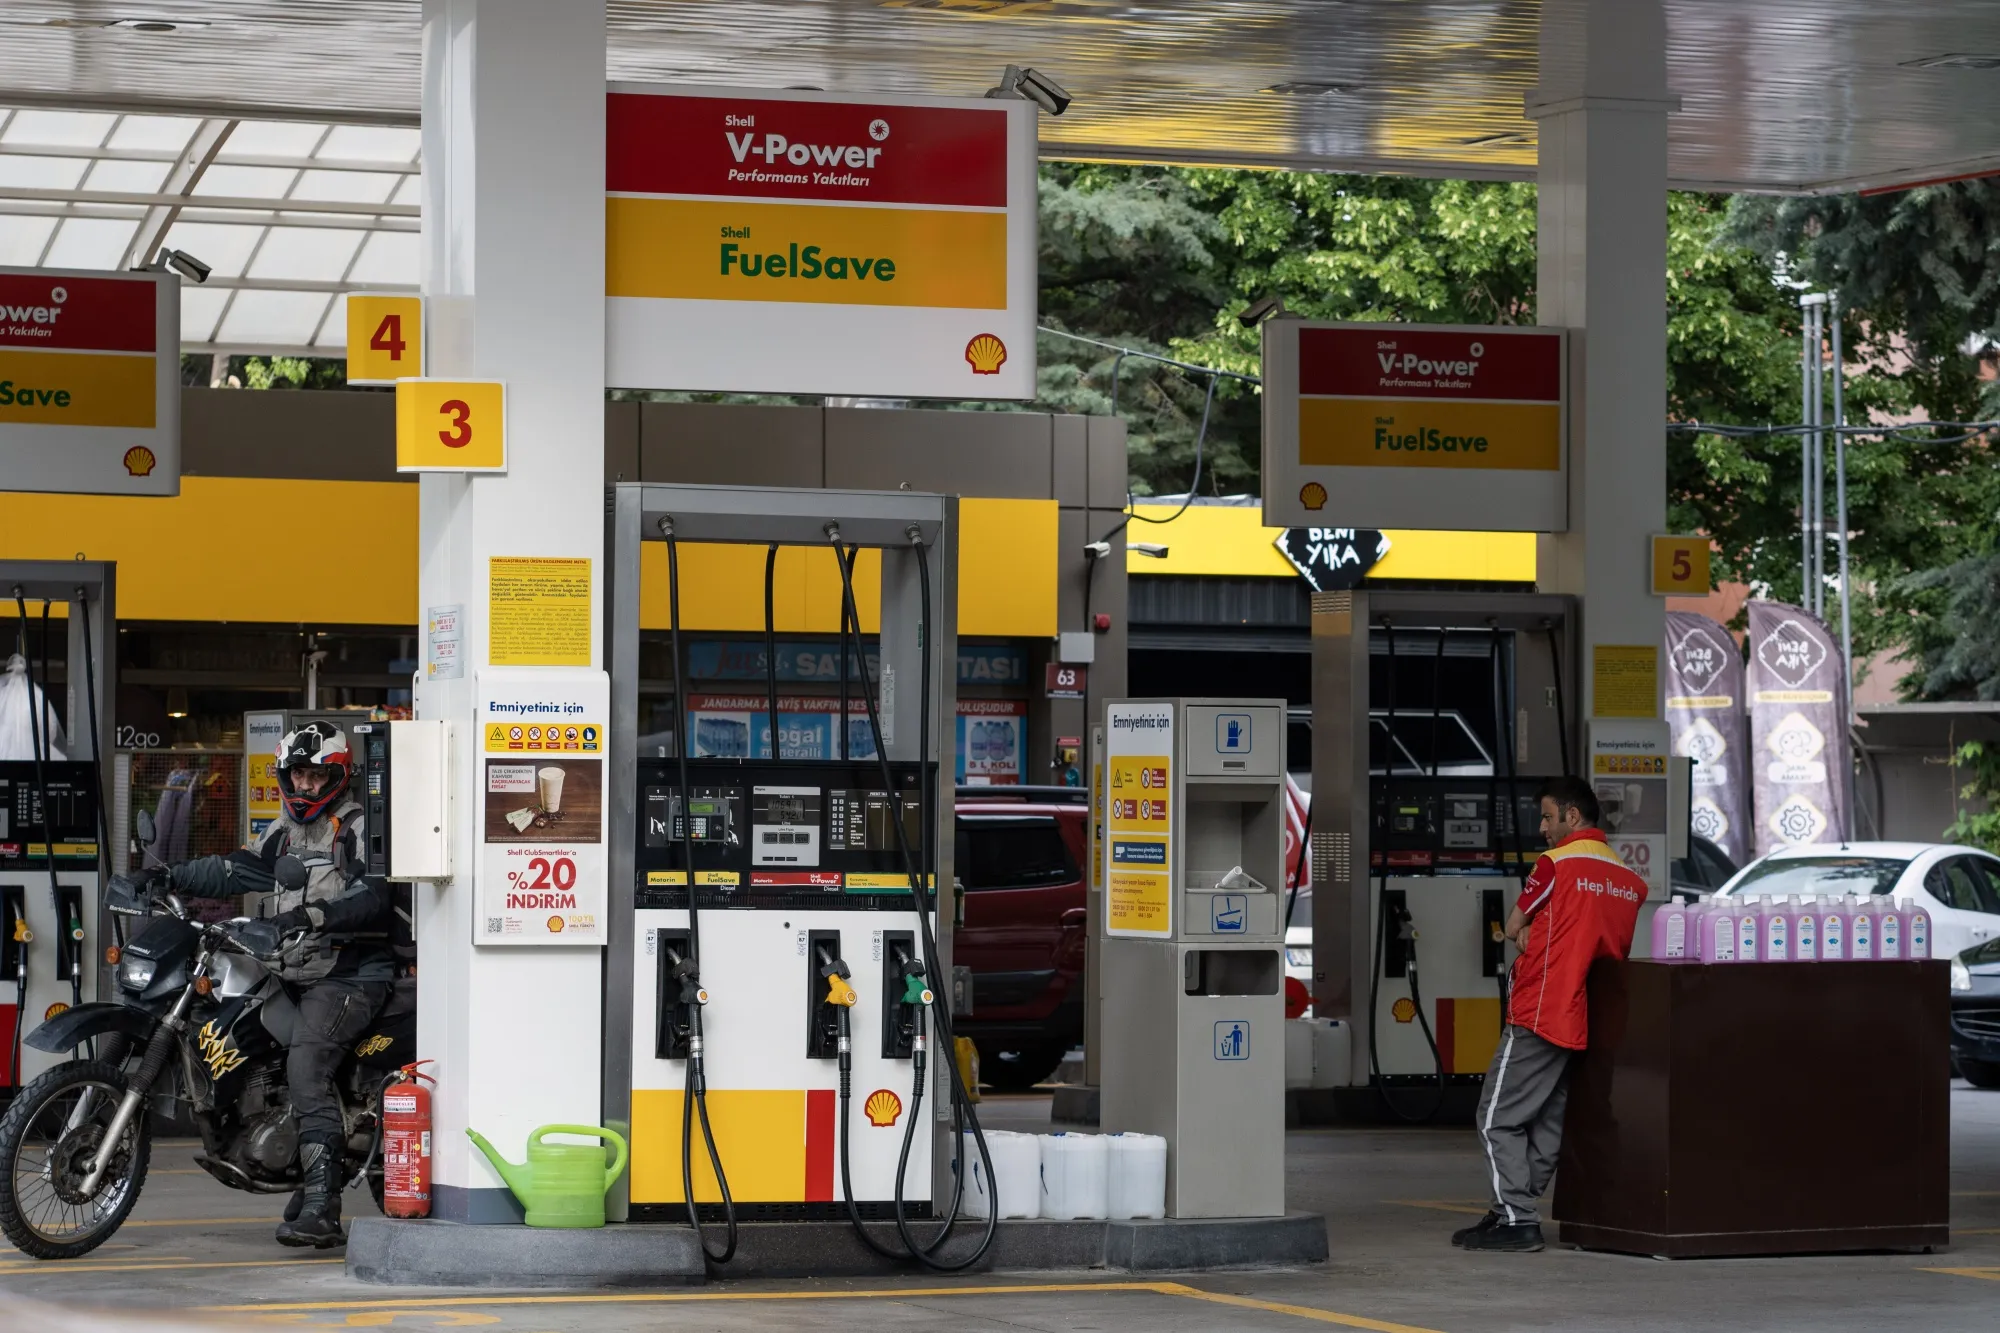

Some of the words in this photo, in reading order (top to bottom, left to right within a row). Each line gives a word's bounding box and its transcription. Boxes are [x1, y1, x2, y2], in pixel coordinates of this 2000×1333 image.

[725, 115, 754, 127] Shell
[725, 132, 881, 168] V-Power
[728, 169, 808, 184] Performans
[812, 172, 870, 186] Yakıtları
[720, 227, 750, 238] Shell
[720, 242, 896, 282] FuelSave
[8, 326, 52, 336] Yakıtları
[370, 315, 406, 360] 4
[1377, 341, 1396, 350] Shell
[1378, 353, 1478, 377] V-Power
[1380, 378, 1432, 388] Performans
[1434, 379, 1472, 389] Yakıtları
[438, 400, 472, 448] 3
[1375, 416, 1394, 426] Shell
[1374, 428, 1488, 452] FuelSave
[1306, 542, 1360, 571] YIKA
[1672, 550, 1691, 581] 5
[796, 653, 880, 682] SAIŞ
[957, 656, 1019, 679] TASI
[1057, 669, 1075, 685] 63
[490, 701, 560, 715] Emniyetiniz
[564, 702, 583, 715] için
[702, 698, 759, 710] JANDARMA
[762, 698, 800, 712] AAYİŞ
[1114, 714, 1155, 732] Emniyetiniz
[1157, 714, 1169, 732] için
[117, 726, 160, 749] i2go
[1596, 740, 1640, 750] Emniyetiniz
[762, 748, 821, 758] mneralli
[1620, 843, 1650, 865] 20
[508, 858, 576, 891] %20
[1576, 877, 1604, 896] Hep
[1606, 878, 1638, 902] İleride
